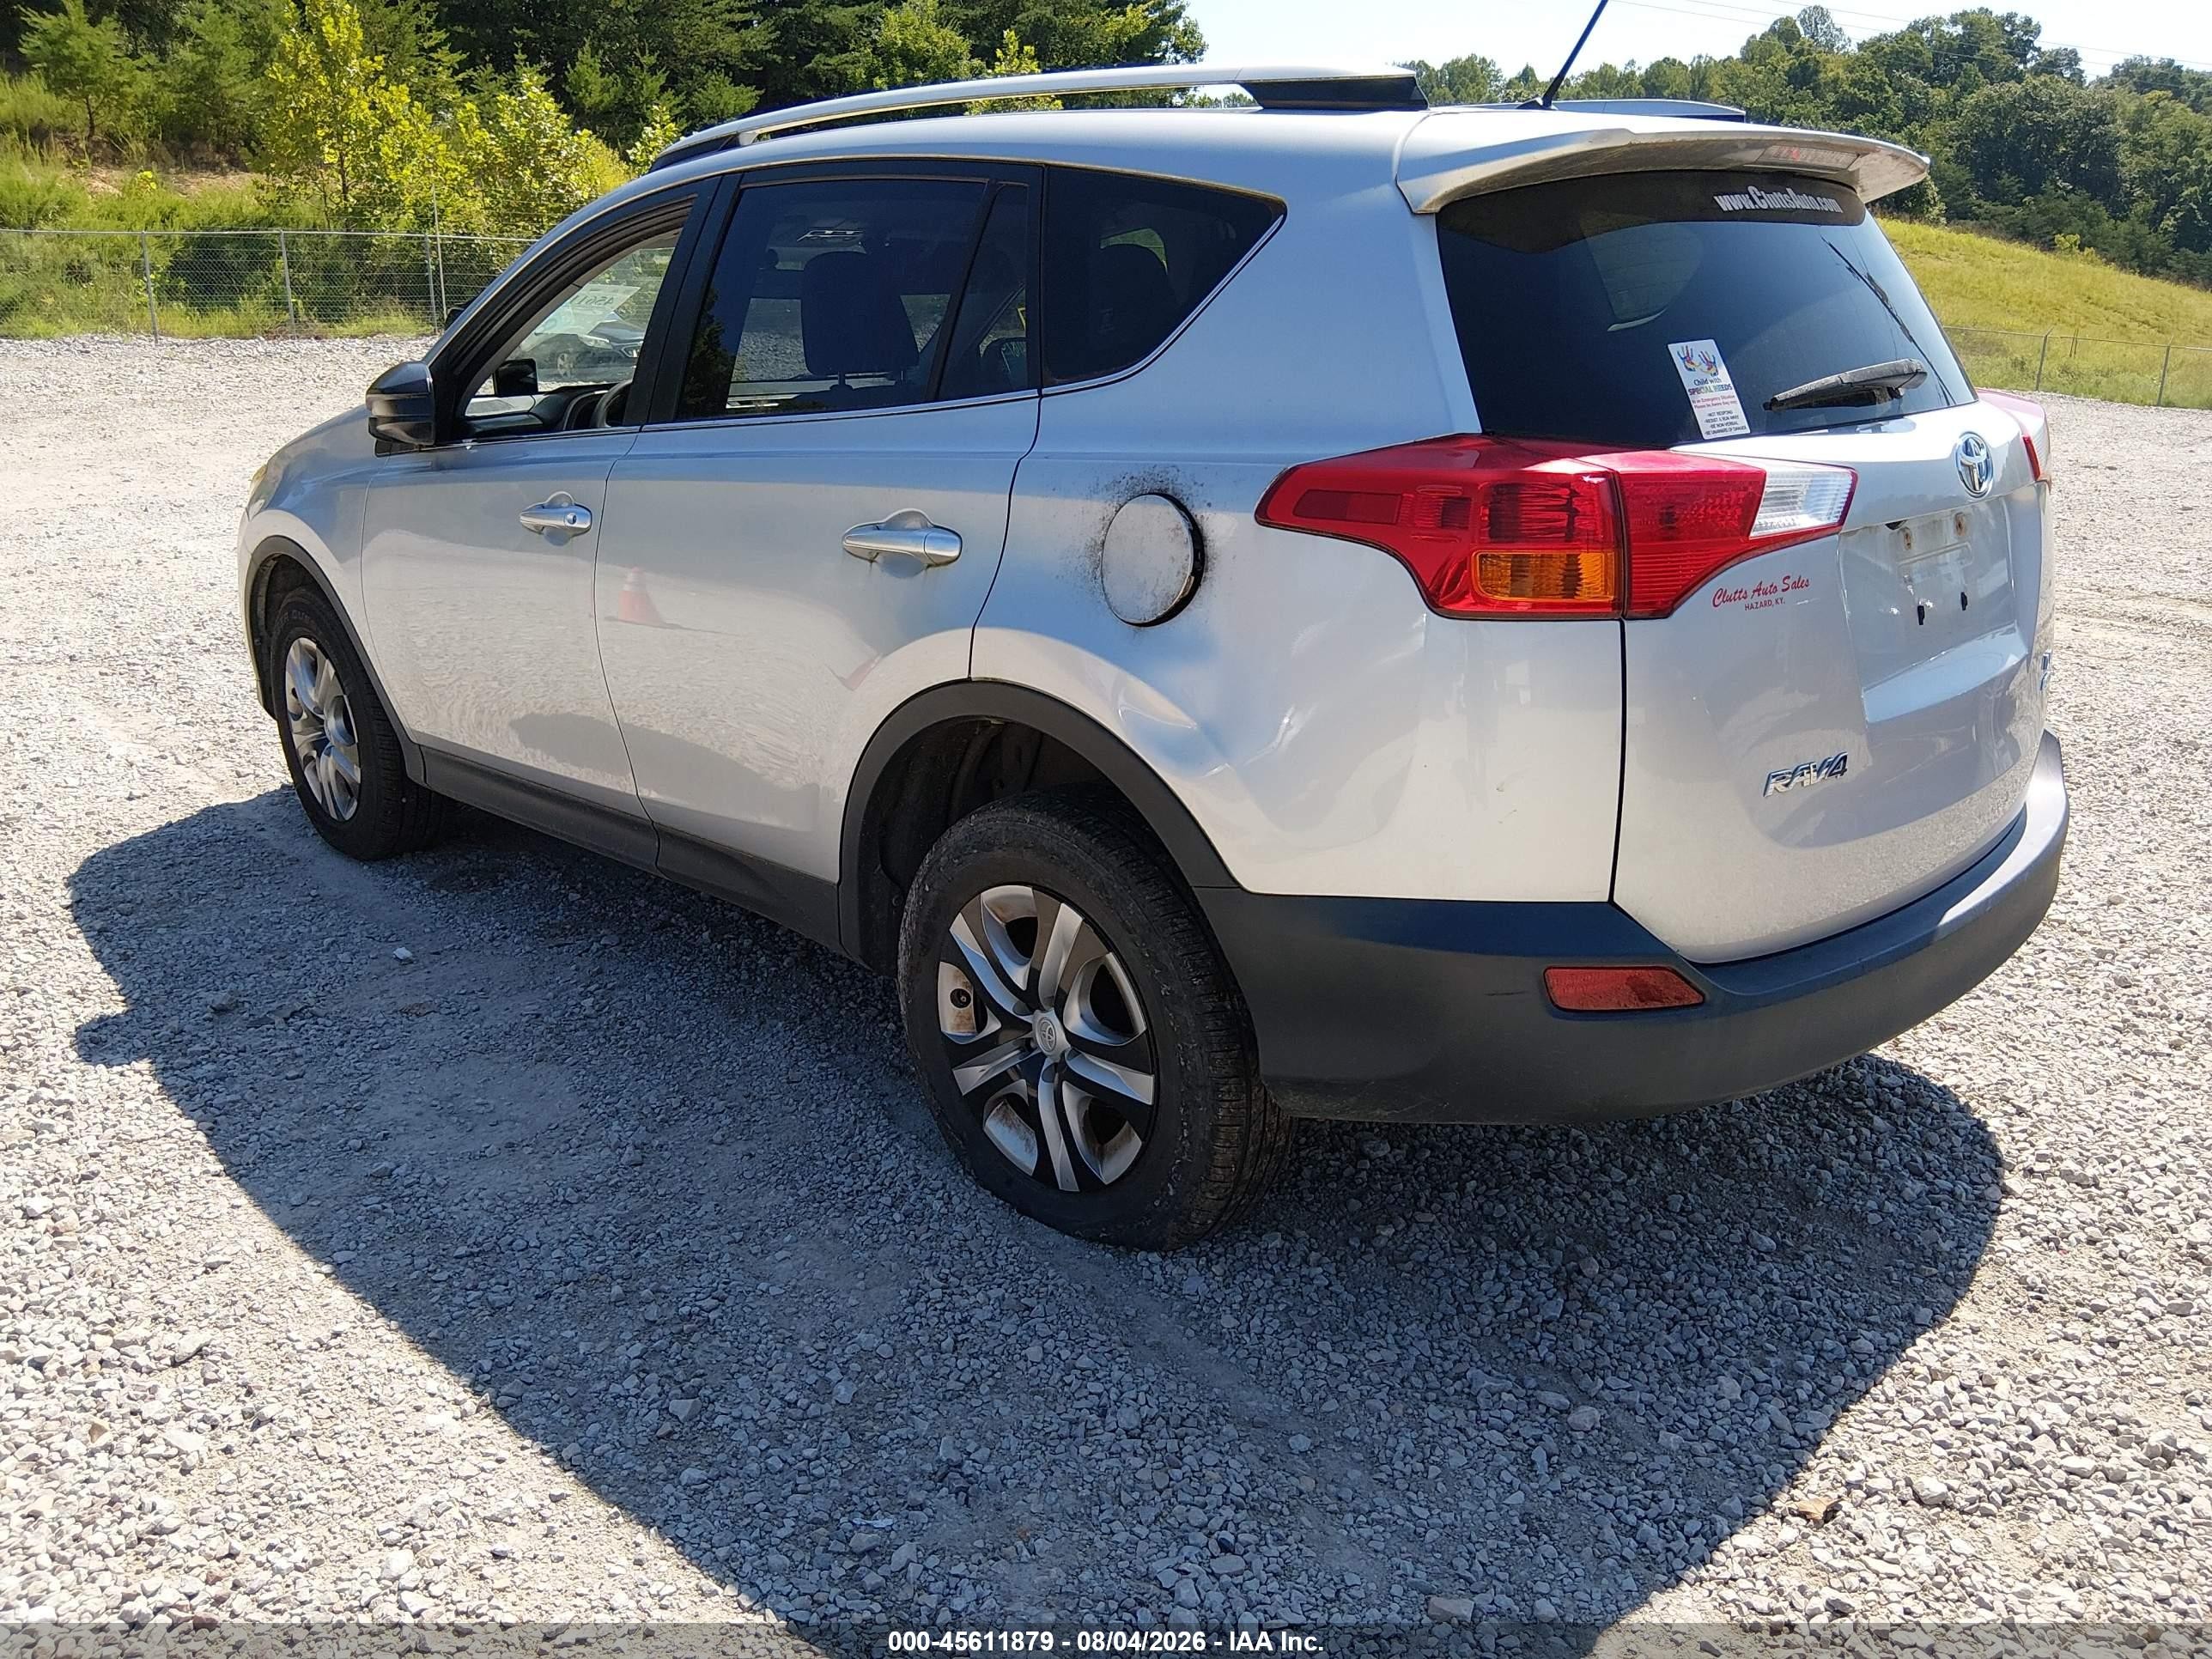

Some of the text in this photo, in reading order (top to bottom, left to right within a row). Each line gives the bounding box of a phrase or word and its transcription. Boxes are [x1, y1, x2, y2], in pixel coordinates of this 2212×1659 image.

[1713, 185, 1844, 214] www.CluttsAuto.com
[1688, 385, 1714, 395] SPECIAL
[1712, 574, 1810, 608] Clutts Auto Sales
[1744, 597, 1786, 611] HAZARD, KY.
[1763, 751, 1848, 798] RAV4
